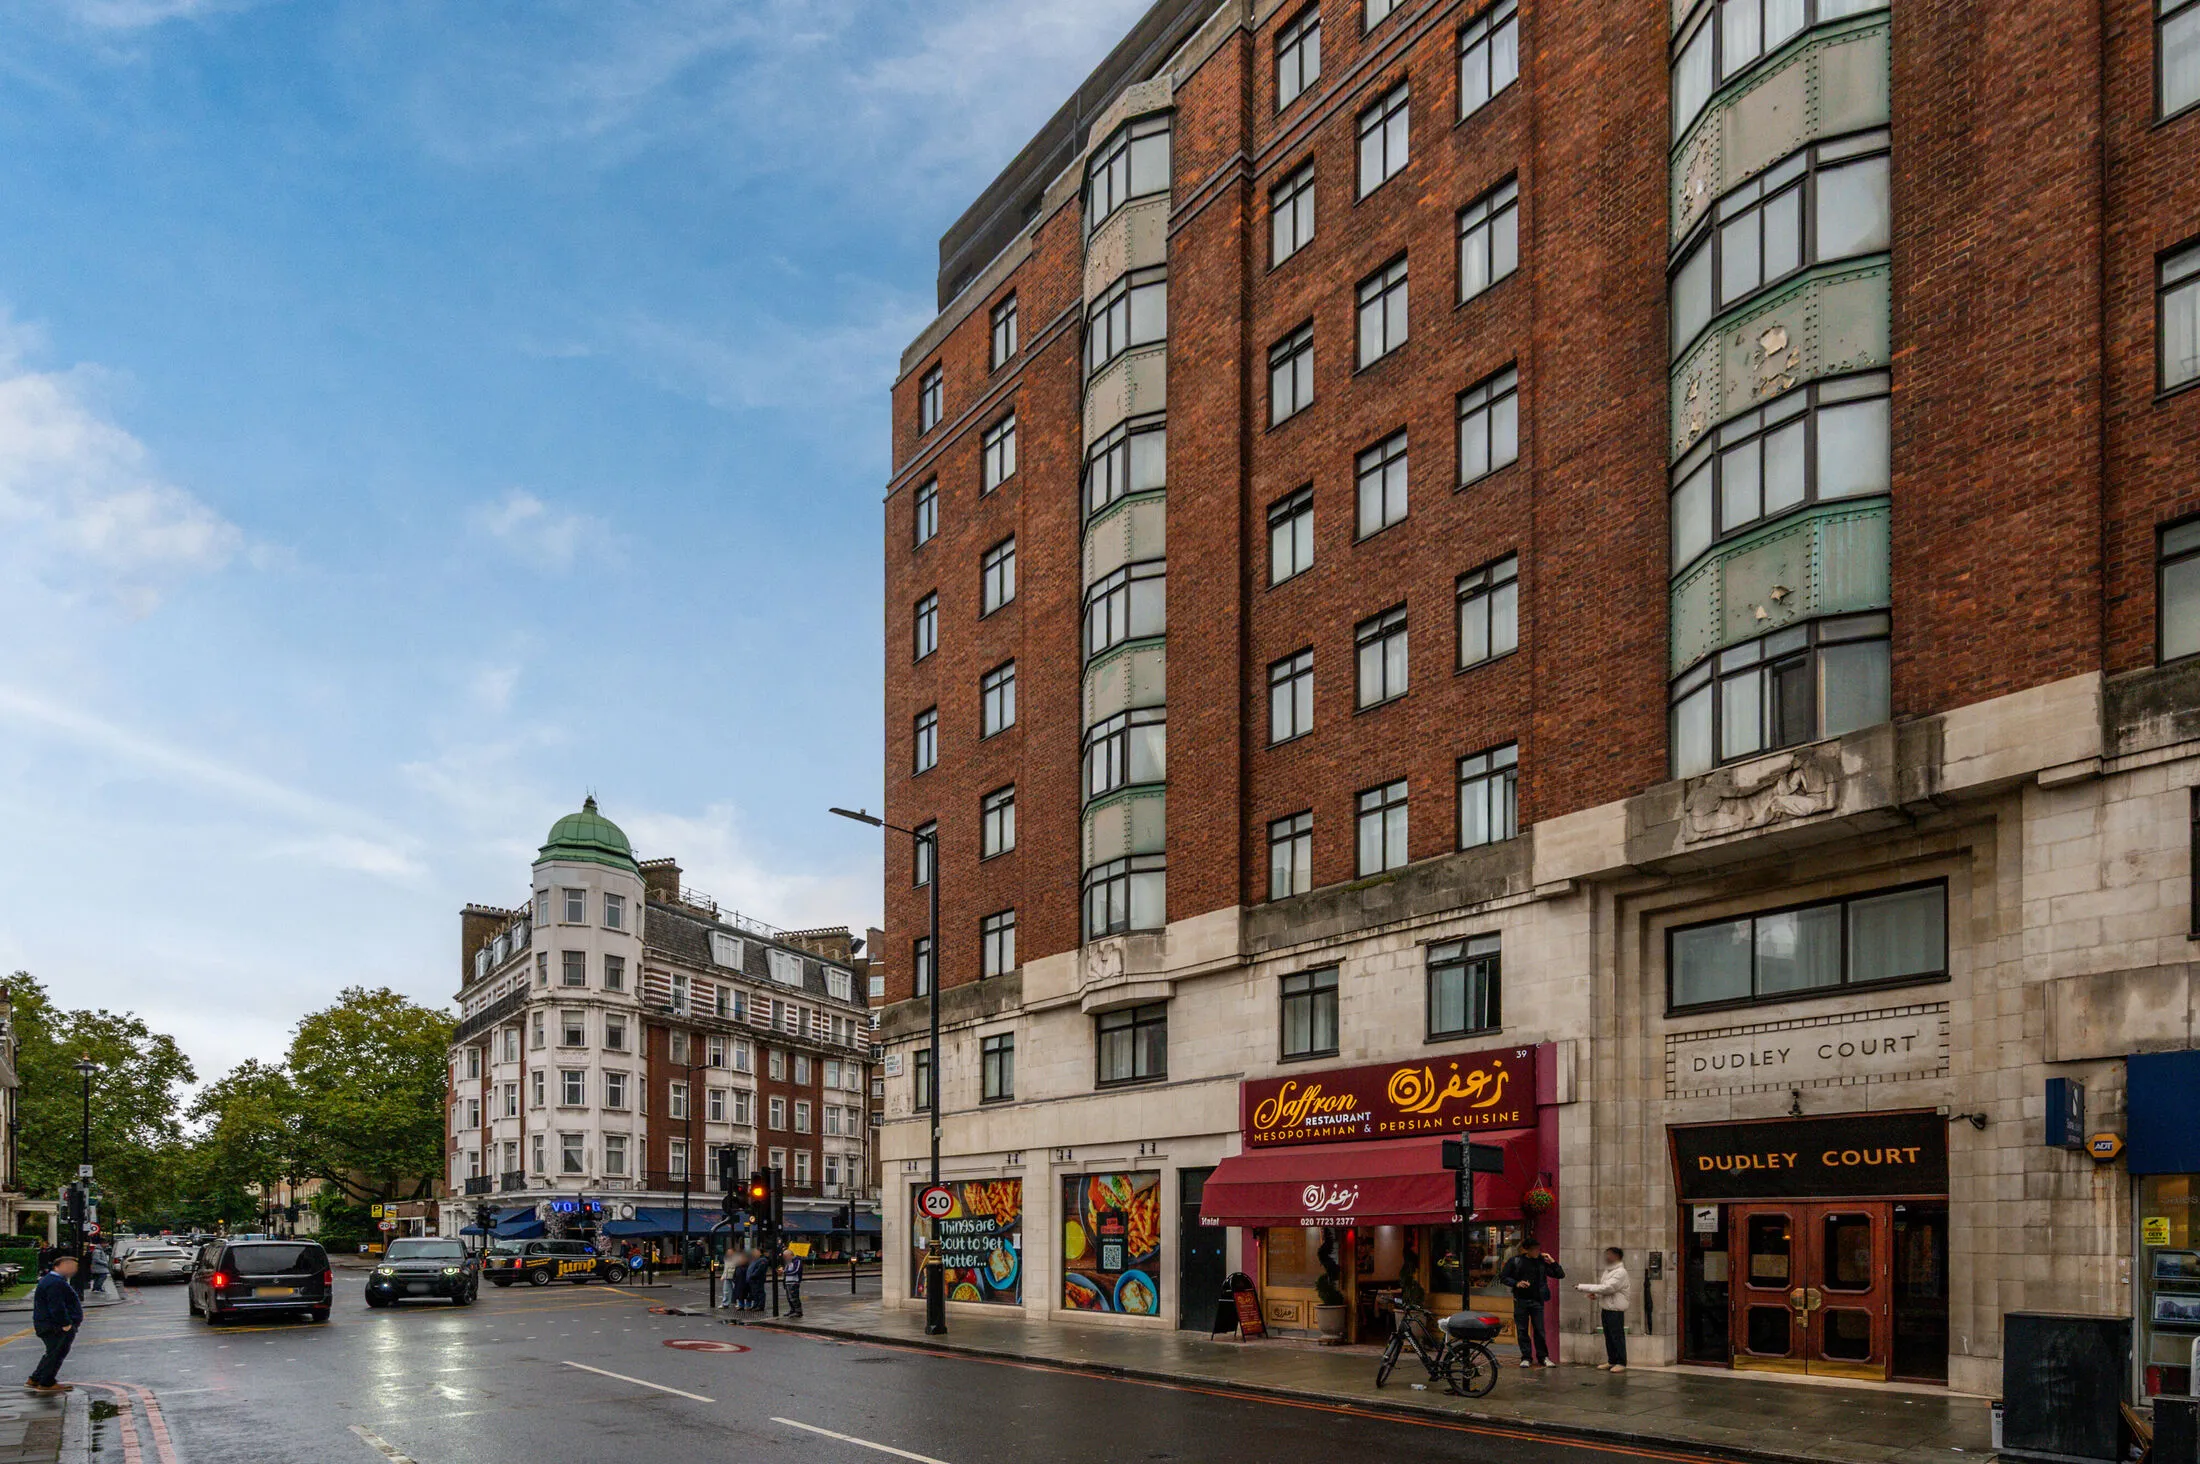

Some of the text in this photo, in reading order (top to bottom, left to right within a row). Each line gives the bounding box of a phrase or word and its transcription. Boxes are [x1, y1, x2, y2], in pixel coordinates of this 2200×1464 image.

[1516, 1050, 1527, 1058] 39
[1694, 1035, 1916, 1072] DUDLEY COURT
[1254, 1081, 1357, 1130] Saffron
[1254, 1111, 1519, 1141] MESOPOTAMIAN & PERSIAN CUISINE
[1305, 1111, 1371, 1126] RESTAURANT
[2094, 1142, 2113, 1150] ADT
[1698, 1147, 1921, 1171] DUDLEY COURT
[928, 1197, 949, 1208] 20
[940, 1219, 995, 1235] Things are
[1300, 1217, 1354, 1226] 020 7723 2377
[940, 1236, 1003, 1250] bout to get
[556, 1258, 597, 1278] jump
